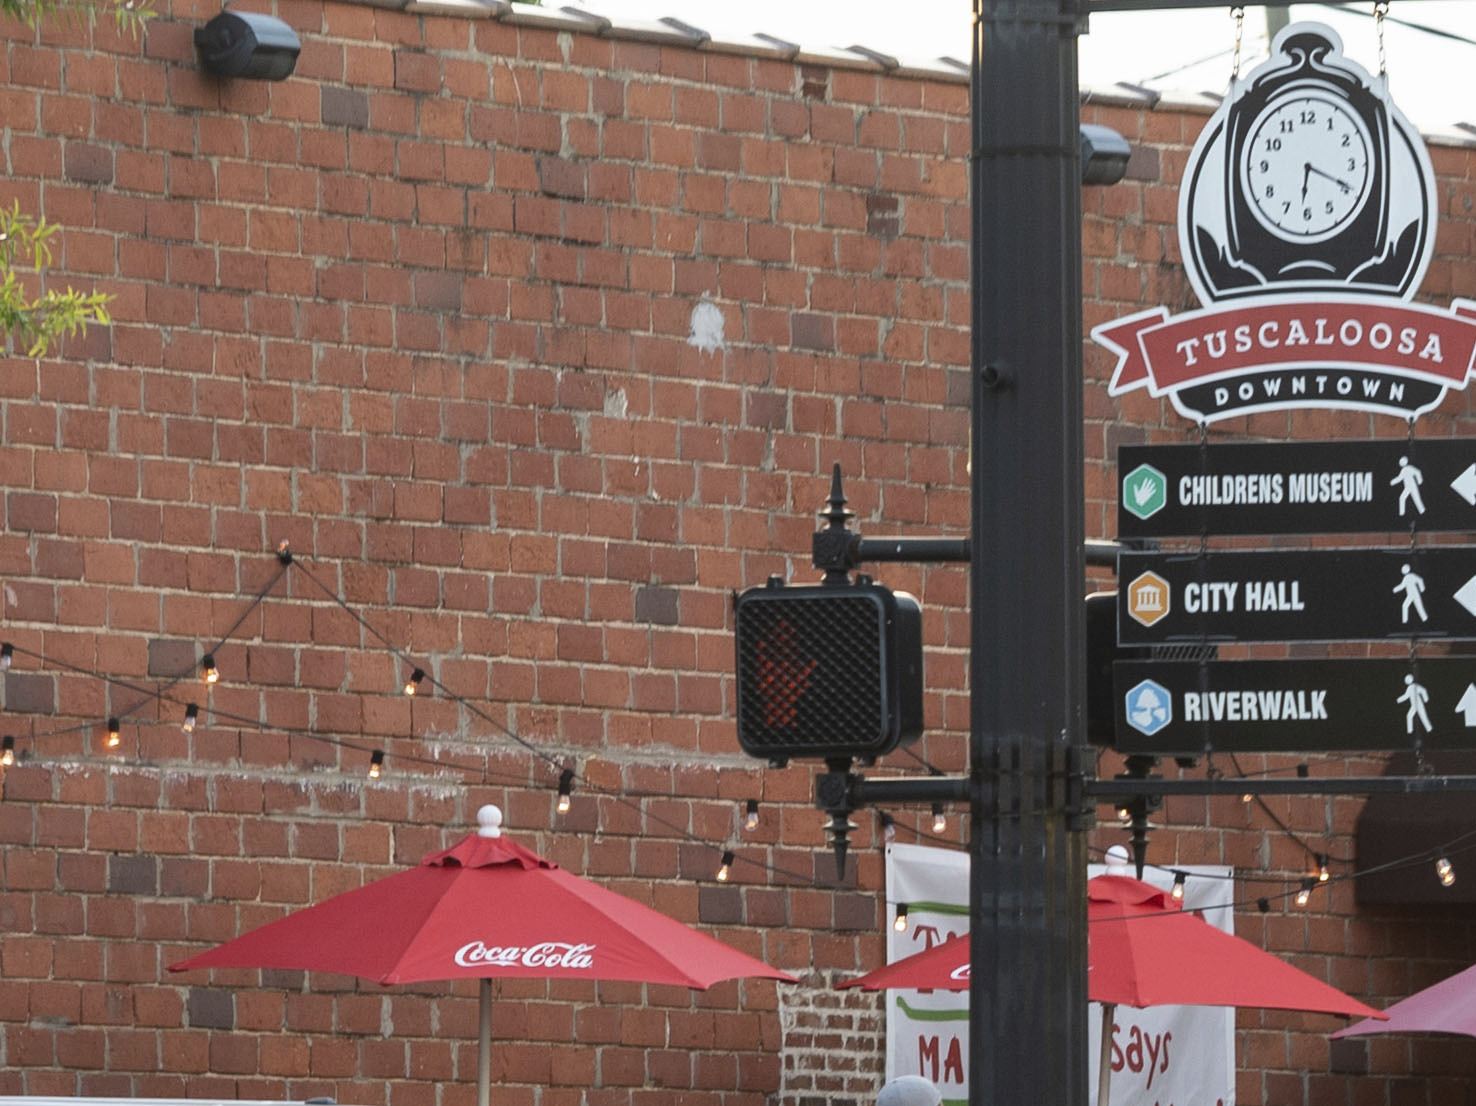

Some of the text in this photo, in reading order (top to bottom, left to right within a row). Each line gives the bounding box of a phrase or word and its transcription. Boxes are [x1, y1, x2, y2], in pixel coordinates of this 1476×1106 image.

[1299, 110, 1316, 125] 12
[1327, 117, 1334, 131] 1
[1280, 119, 1294, 134] 11
[1265, 137, 1282, 152] 10
[1341, 133, 1351, 148] 2
[1259, 159, 1269, 174] 9
[1347, 158, 1356, 172] 3
[1265, 184, 1275, 198] 8
[1282, 200, 1291, 214] 7
[1303, 207, 1312, 221] 6
[1325, 200, 1334, 214] 5
[1176, 318, 1445, 367] TUSCALOOSA
[1214, 375, 1406, 407] DOWNTOWN
[1178, 472, 1373, 506] CHILDRENS MUSEUM
[1184, 580, 1305, 614] CITY HALL
[1184, 690, 1328, 721] RIVERWALK
[454, 940, 596, 969] Coca-Cola
[918, 1034, 964, 1083] MA
[1111, 1024, 1172, 1090] says
